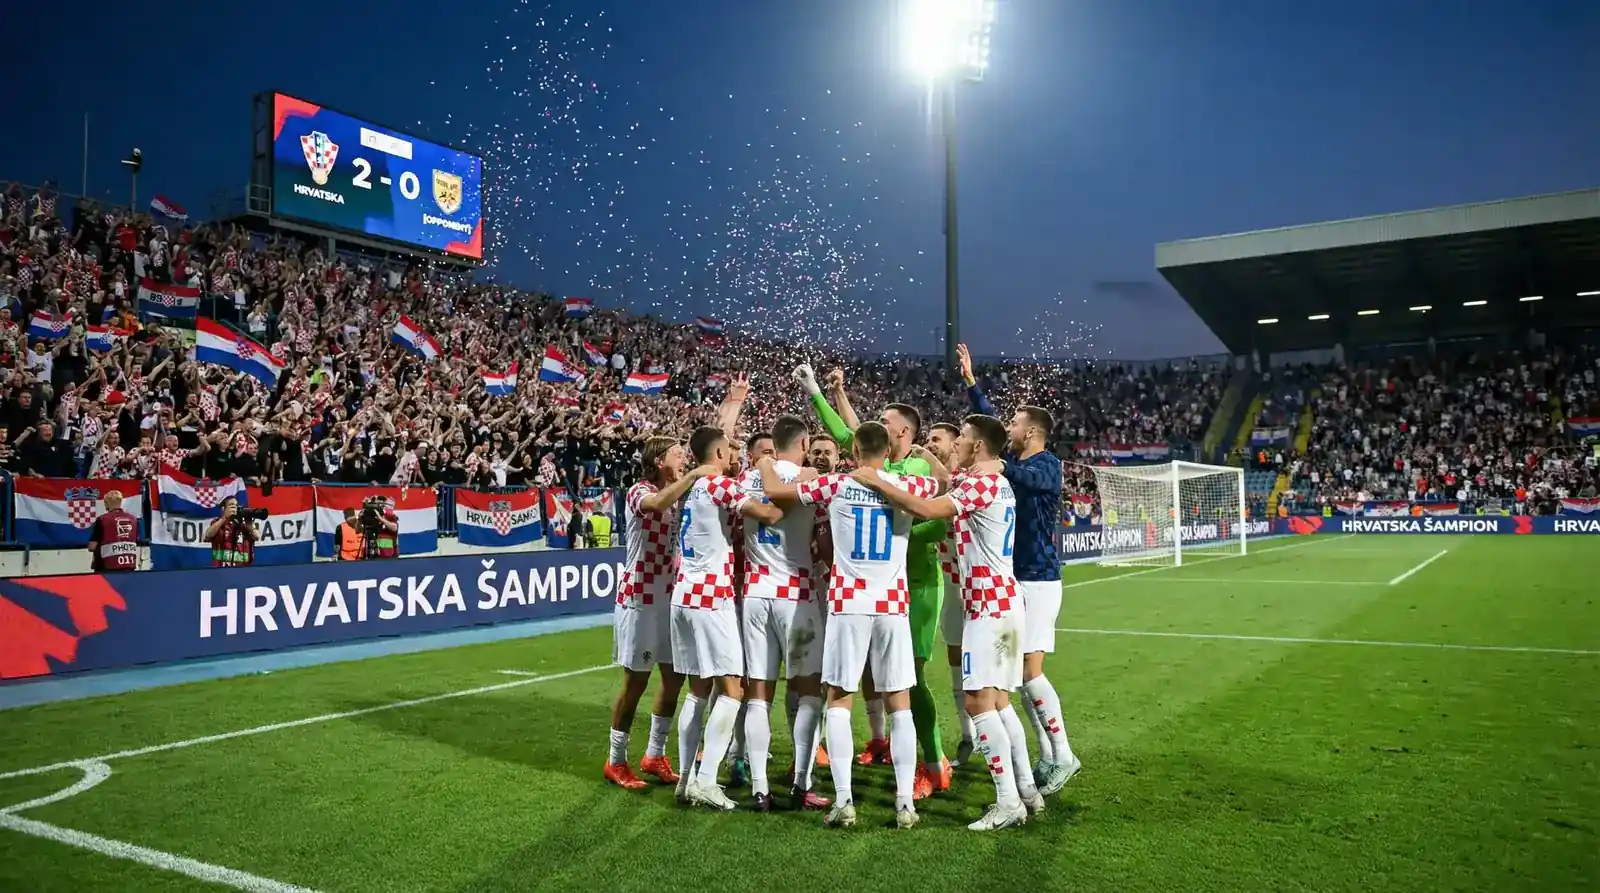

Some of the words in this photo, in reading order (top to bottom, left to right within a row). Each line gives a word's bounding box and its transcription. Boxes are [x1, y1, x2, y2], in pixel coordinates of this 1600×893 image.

[352, 157, 372, 189] 2
[399, 171, 420, 200] 0
[293, 183, 345, 205] HRVATSKA
[850, 507, 893, 561] 10
[1342, 520, 1421, 532] HRVATSKA
[1423, 517, 1498, 532] ŠAMPION
[1554, 520, 1600, 532] HRVA
[1062, 531, 1106, 553] HRVATSKA
[200, 573, 467, 638] HRVATSKA
